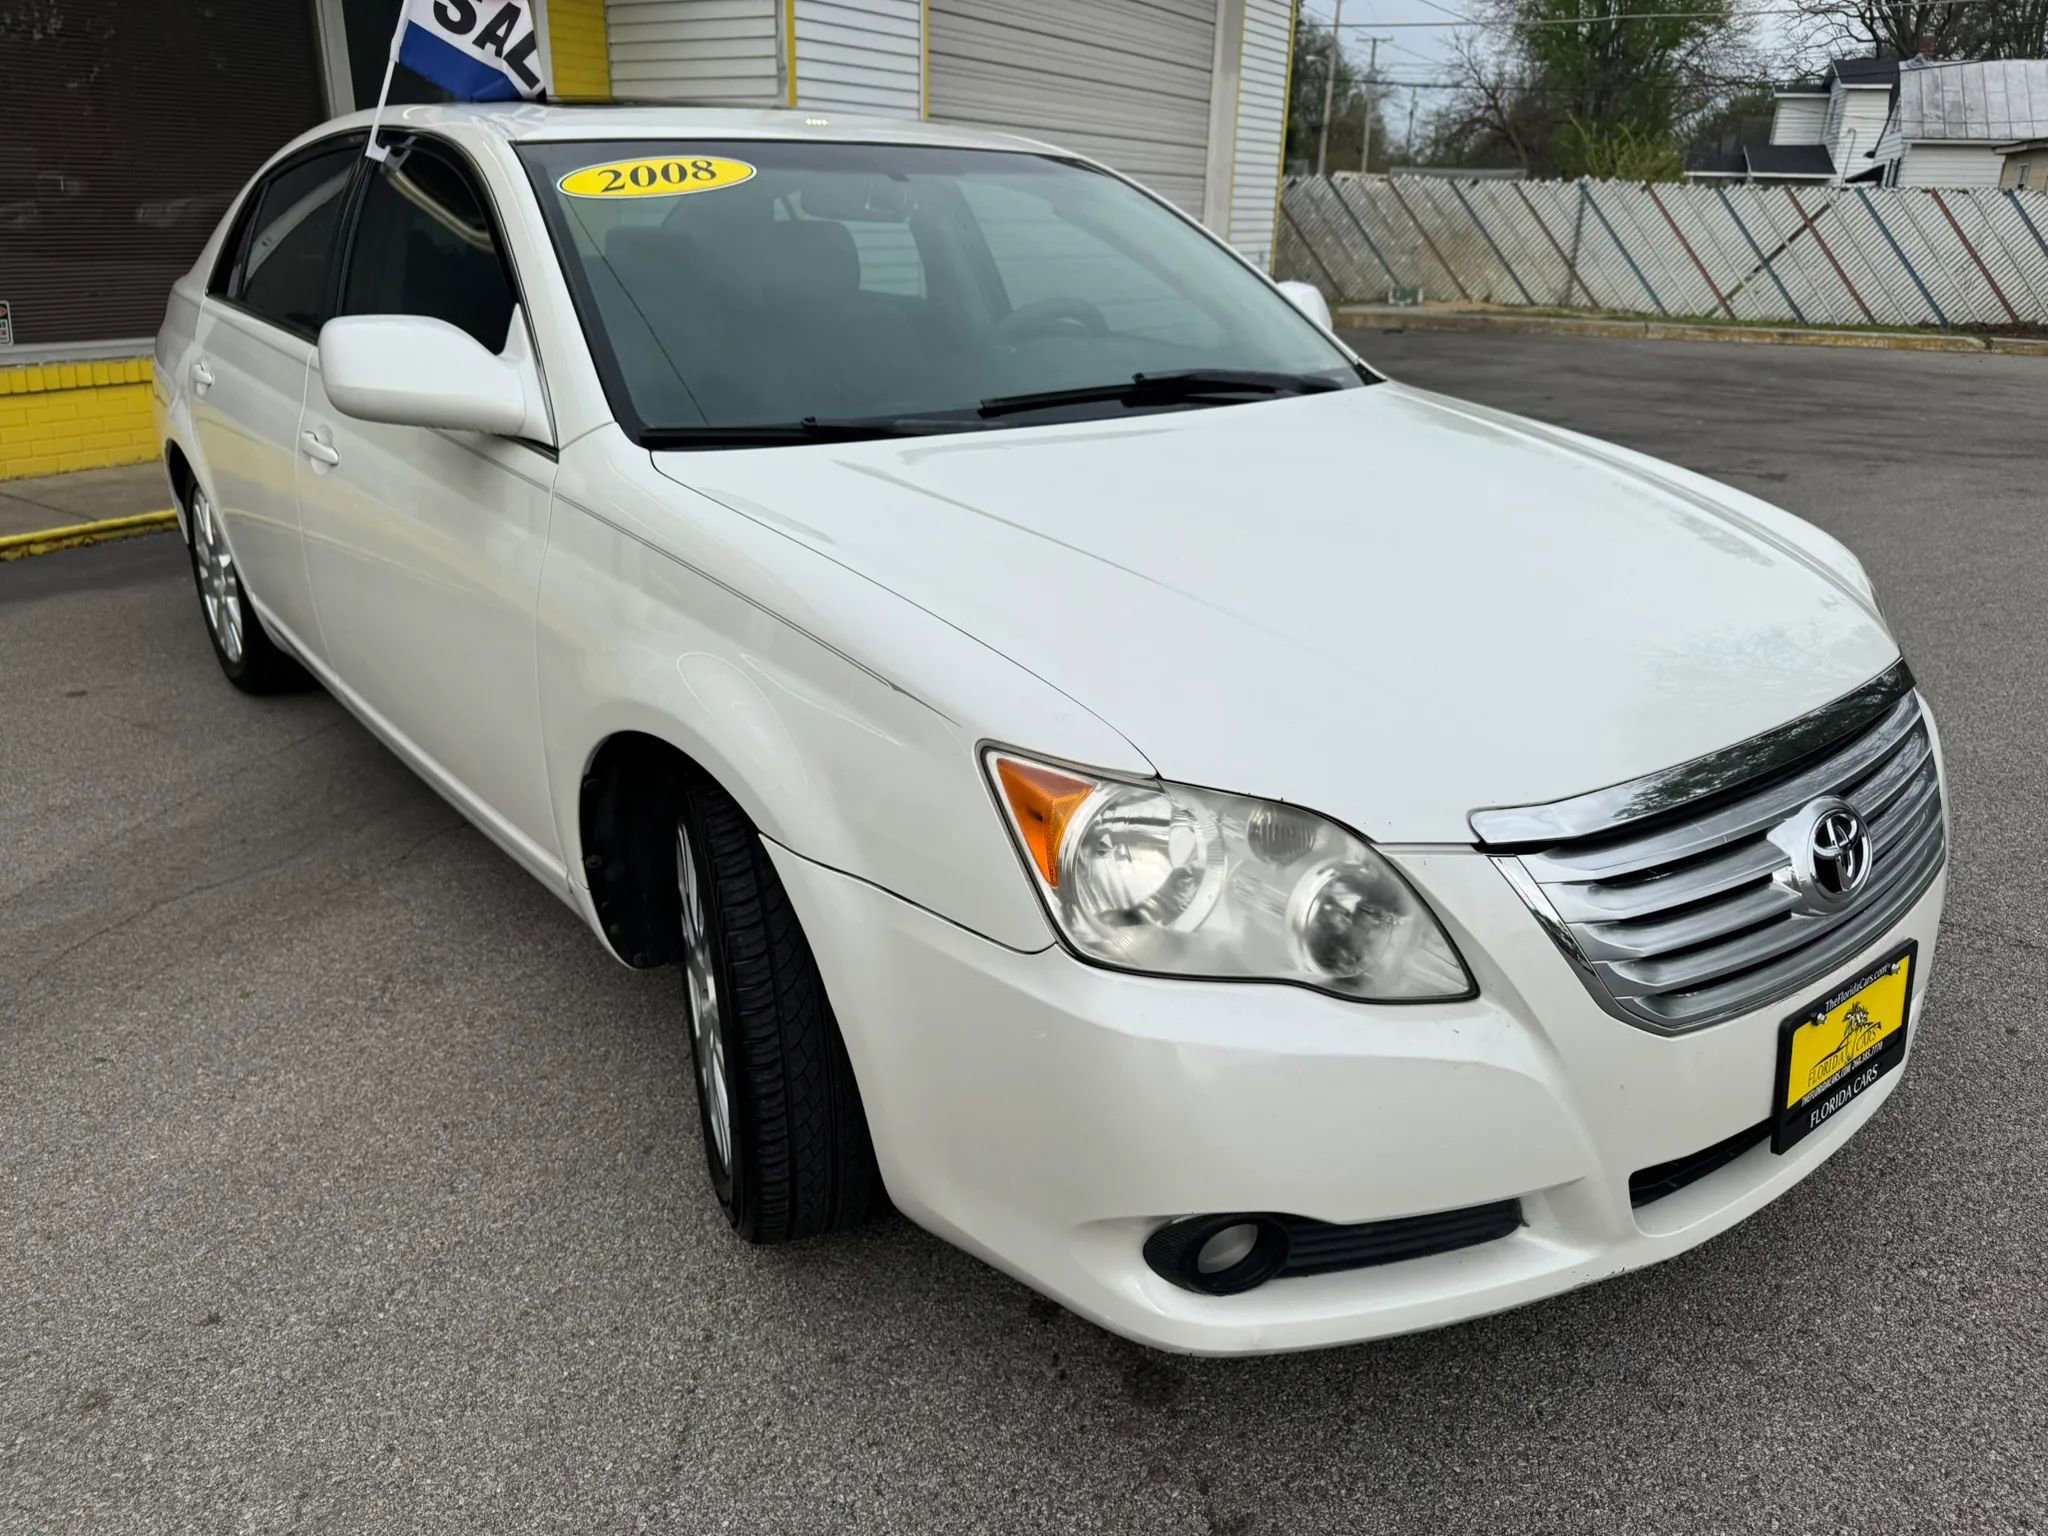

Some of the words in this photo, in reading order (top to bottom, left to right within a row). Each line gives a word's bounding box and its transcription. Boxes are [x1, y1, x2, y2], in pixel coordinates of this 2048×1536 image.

[433, 0, 546, 101] SAL
[598, 160, 717, 192] 2008
[1825, 964, 1888, 1012] TheFloridaCars.com
[1808, 1049, 1847, 1087] FLORIDA
[1855, 1028, 1877, 1051] CARS
[1810, 1084, 1853, 1128] FLORIDA
[1854, 1063, 1879, 1094] CARS
